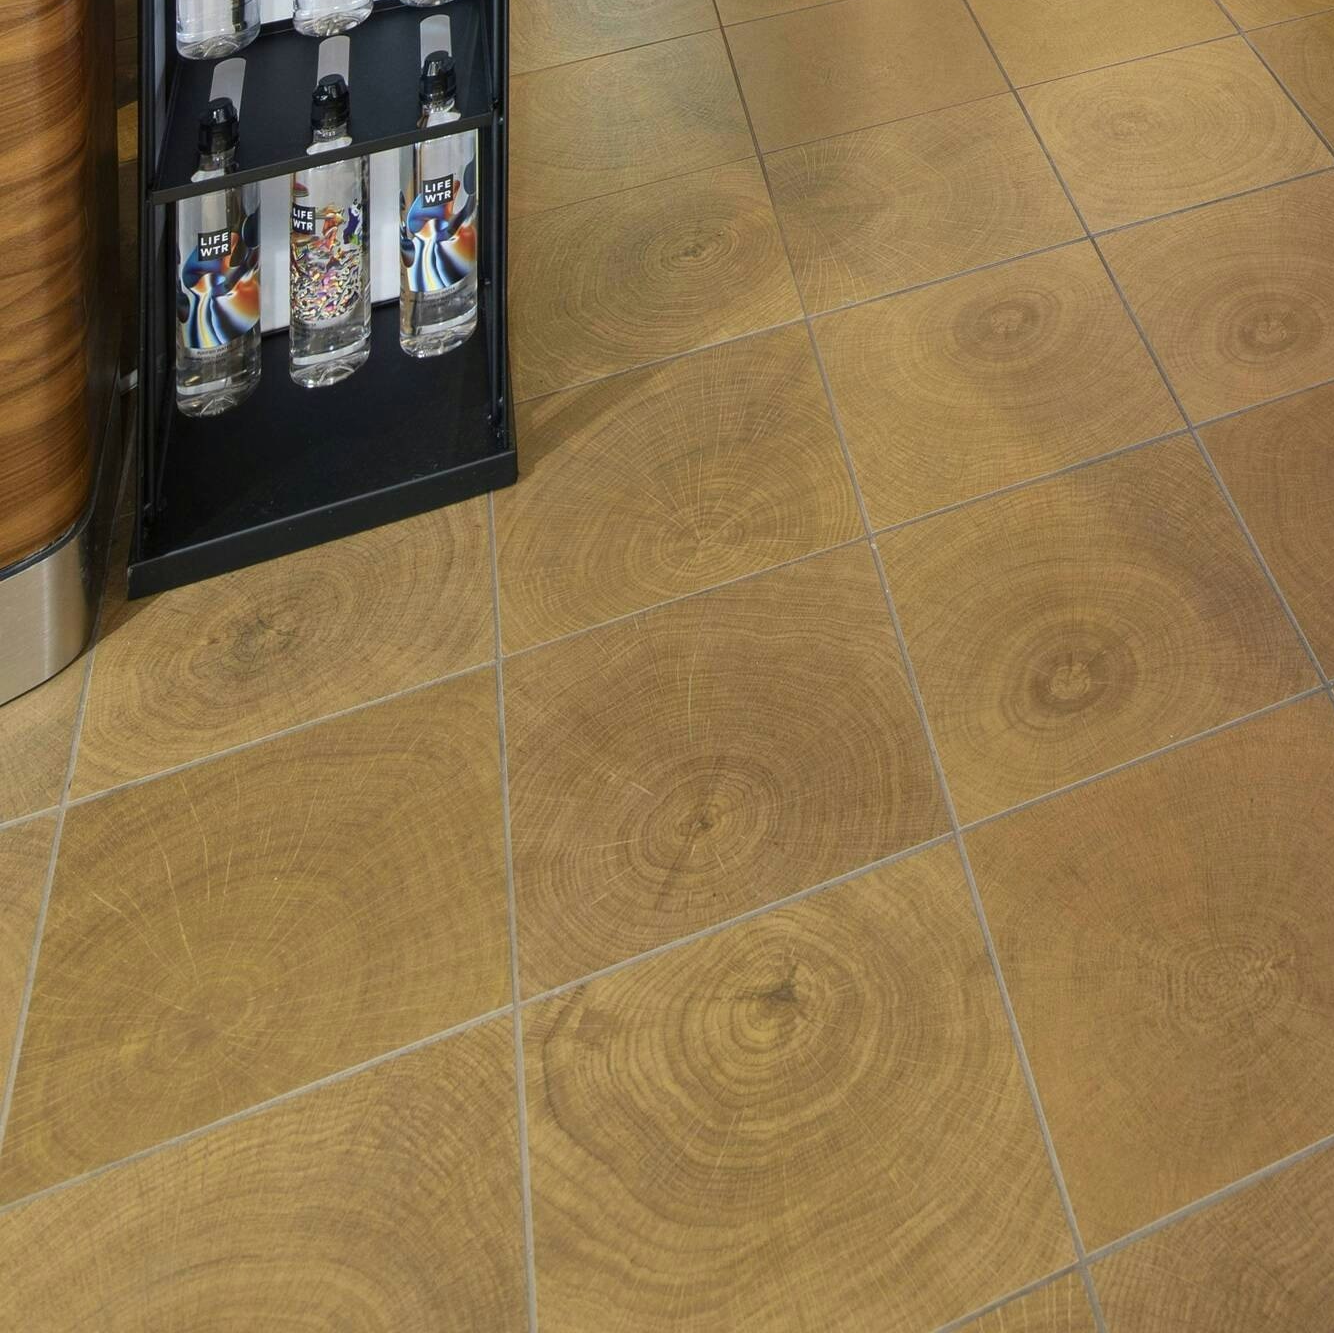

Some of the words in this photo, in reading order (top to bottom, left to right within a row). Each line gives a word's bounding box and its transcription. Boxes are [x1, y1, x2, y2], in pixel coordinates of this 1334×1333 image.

[425, 179, 452, 193] LIFE
[424, 190, 452, 204] WTR
[293, 206, 313, 220] LIFE
[292, 218, 313, 231] WTR
[200, 232, 229, 246] LIFE
[200, 243, 229, 257] WTR
